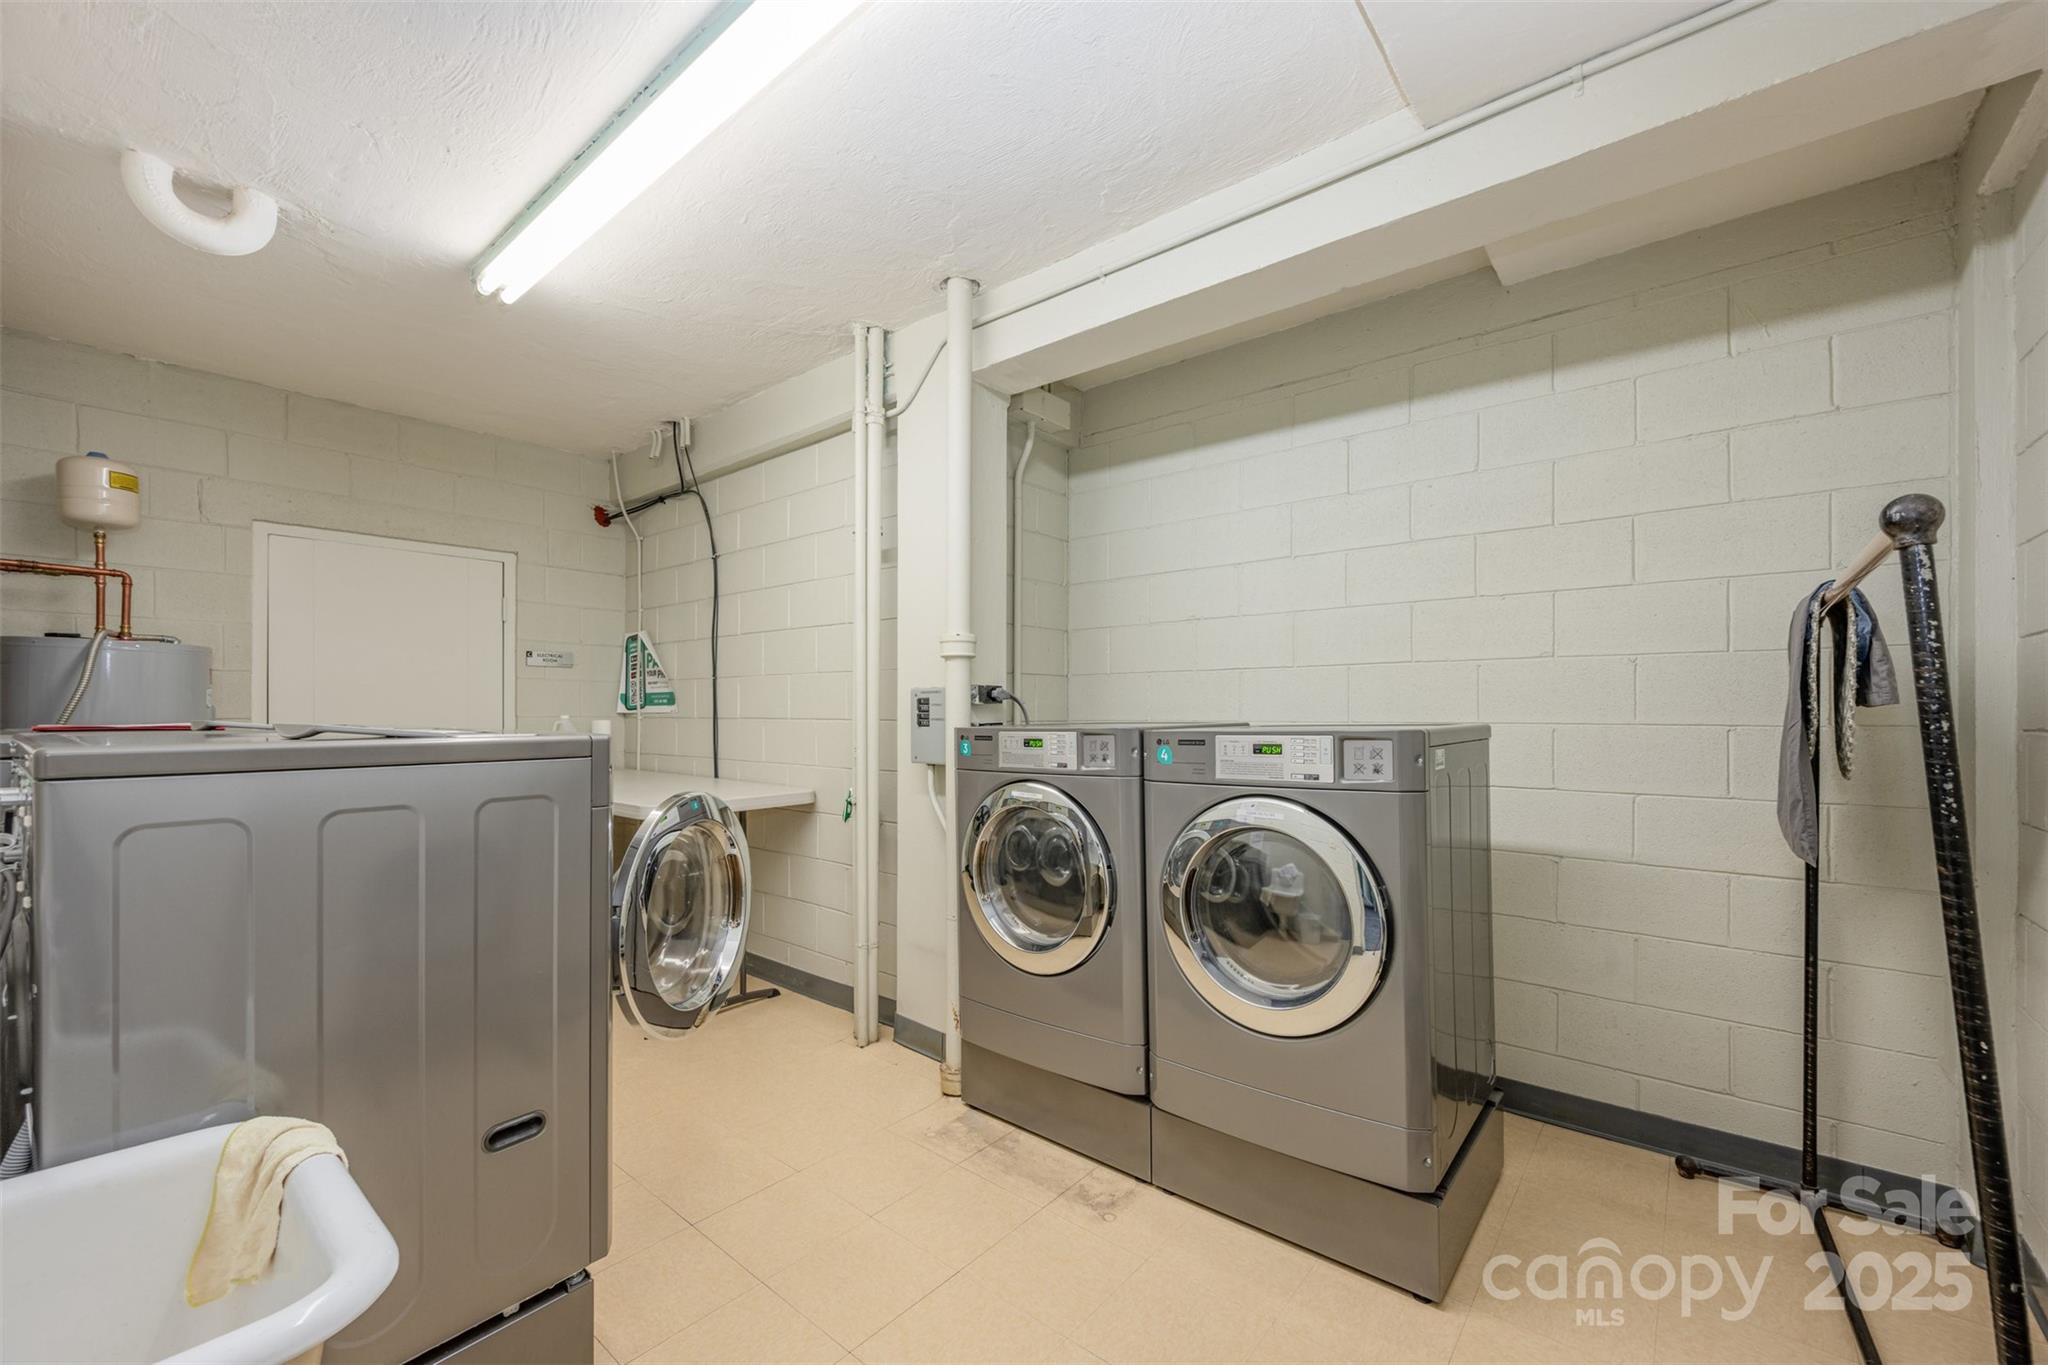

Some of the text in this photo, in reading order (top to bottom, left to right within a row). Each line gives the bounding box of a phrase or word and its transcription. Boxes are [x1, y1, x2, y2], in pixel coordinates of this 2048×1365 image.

[962, 743, 969, 754] 3
[1262, 746, 1281, 754] PUSH
[1160, 748, 1168, 761] 4
